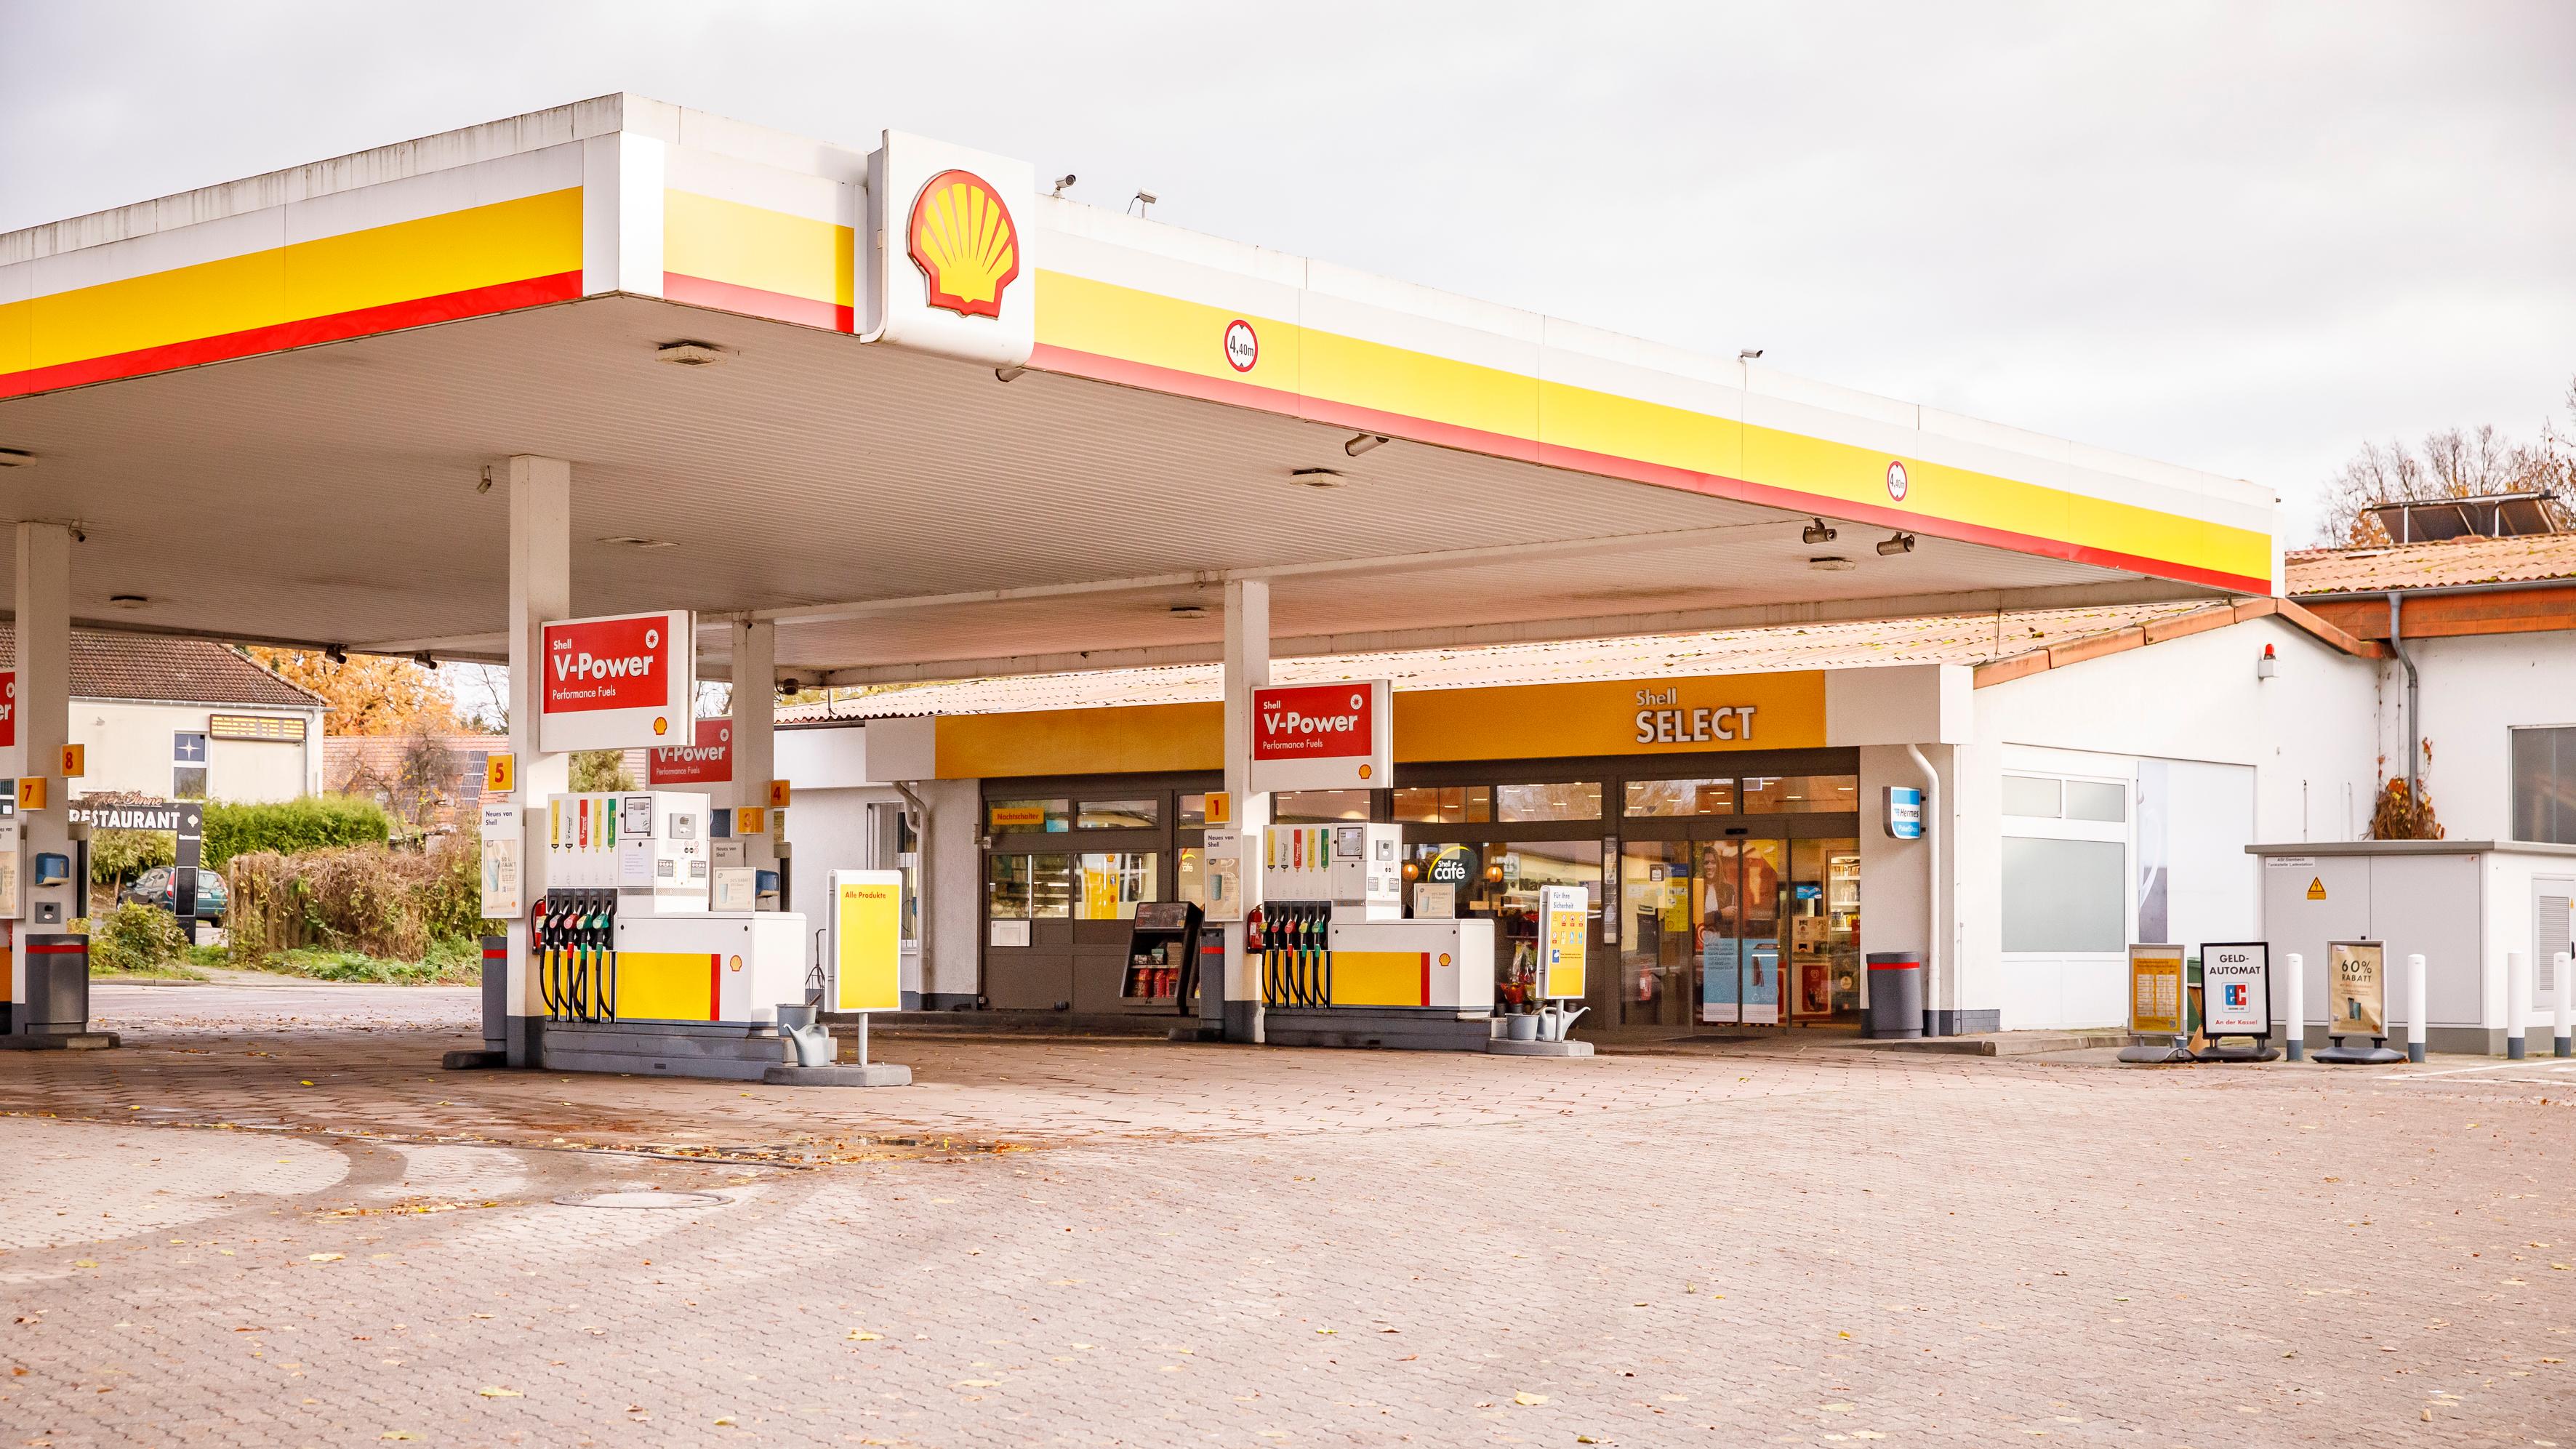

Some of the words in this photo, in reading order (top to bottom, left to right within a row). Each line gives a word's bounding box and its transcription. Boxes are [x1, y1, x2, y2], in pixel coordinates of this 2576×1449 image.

[1230, 335, 1254, 356] 4,40m
[553, 638, 572, 651] Shell
[553, 652, 654, 682] V-Power
[553, 688, 596, 700] Performance
[598, 685, 616, 697] Fuels
[1636, 687, 1677, 706] Shell
[1263, 700, 1281, 710] Shell
[1263, 711, 1358, 735] V-Power
[1636, 706, 1756, 744] SELECT
[1263, 739, 1304, 750] Performance
[1307, 738, 1323, 748] Fuels
[65, 752, 73, 769] 8
[658, 745, 726, 763] V-Power
[494, 763, 505, 783] 5
[656, 767, 686, 776] Performance
[688, 766, 700, 774] Fuels
[25, 784, 33, 802] 7
[773, 786, 781, 801] 4
[1213, 800, 1219, 816] 1
[1900, 808, 1919, 818] Hermes
[68, 809, 181, 829] RESTAURANT
[744, 812, 752, 827] 3
[1434, 862, 1466, 880] café
[2219, 954, 2250, 963] GELD-
[2209, 966, 2261, 975] AUTOMAT
[2342, 960, 2372, 974] 60%
[2342, 974, 2372, 982] RABATT
